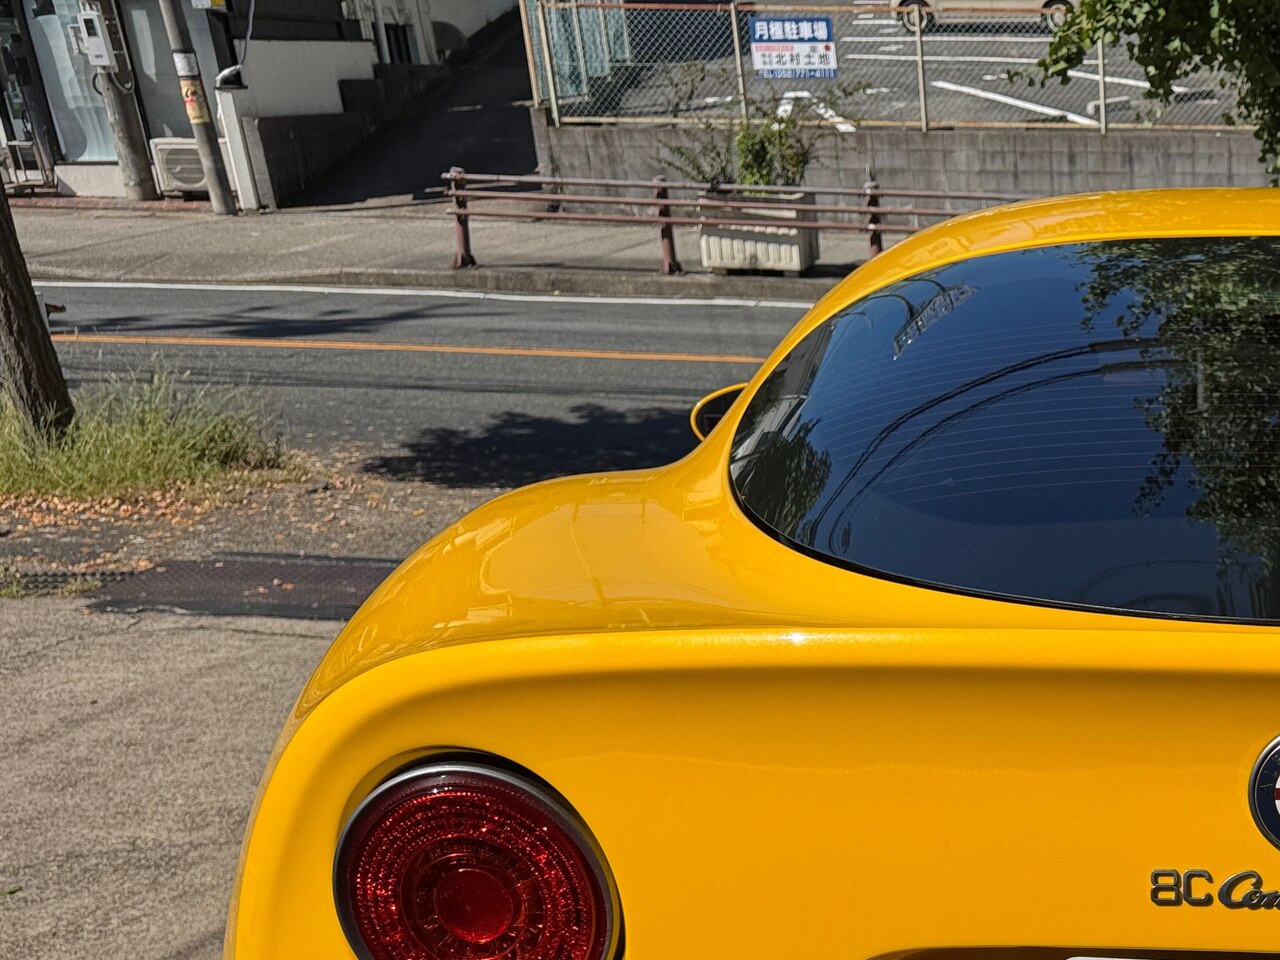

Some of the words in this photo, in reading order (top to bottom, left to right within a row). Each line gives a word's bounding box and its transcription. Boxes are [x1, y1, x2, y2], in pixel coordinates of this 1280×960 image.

[754, 20, 828, 41] 月極駐車場
[1151, 869, 1214, 906] 8C
